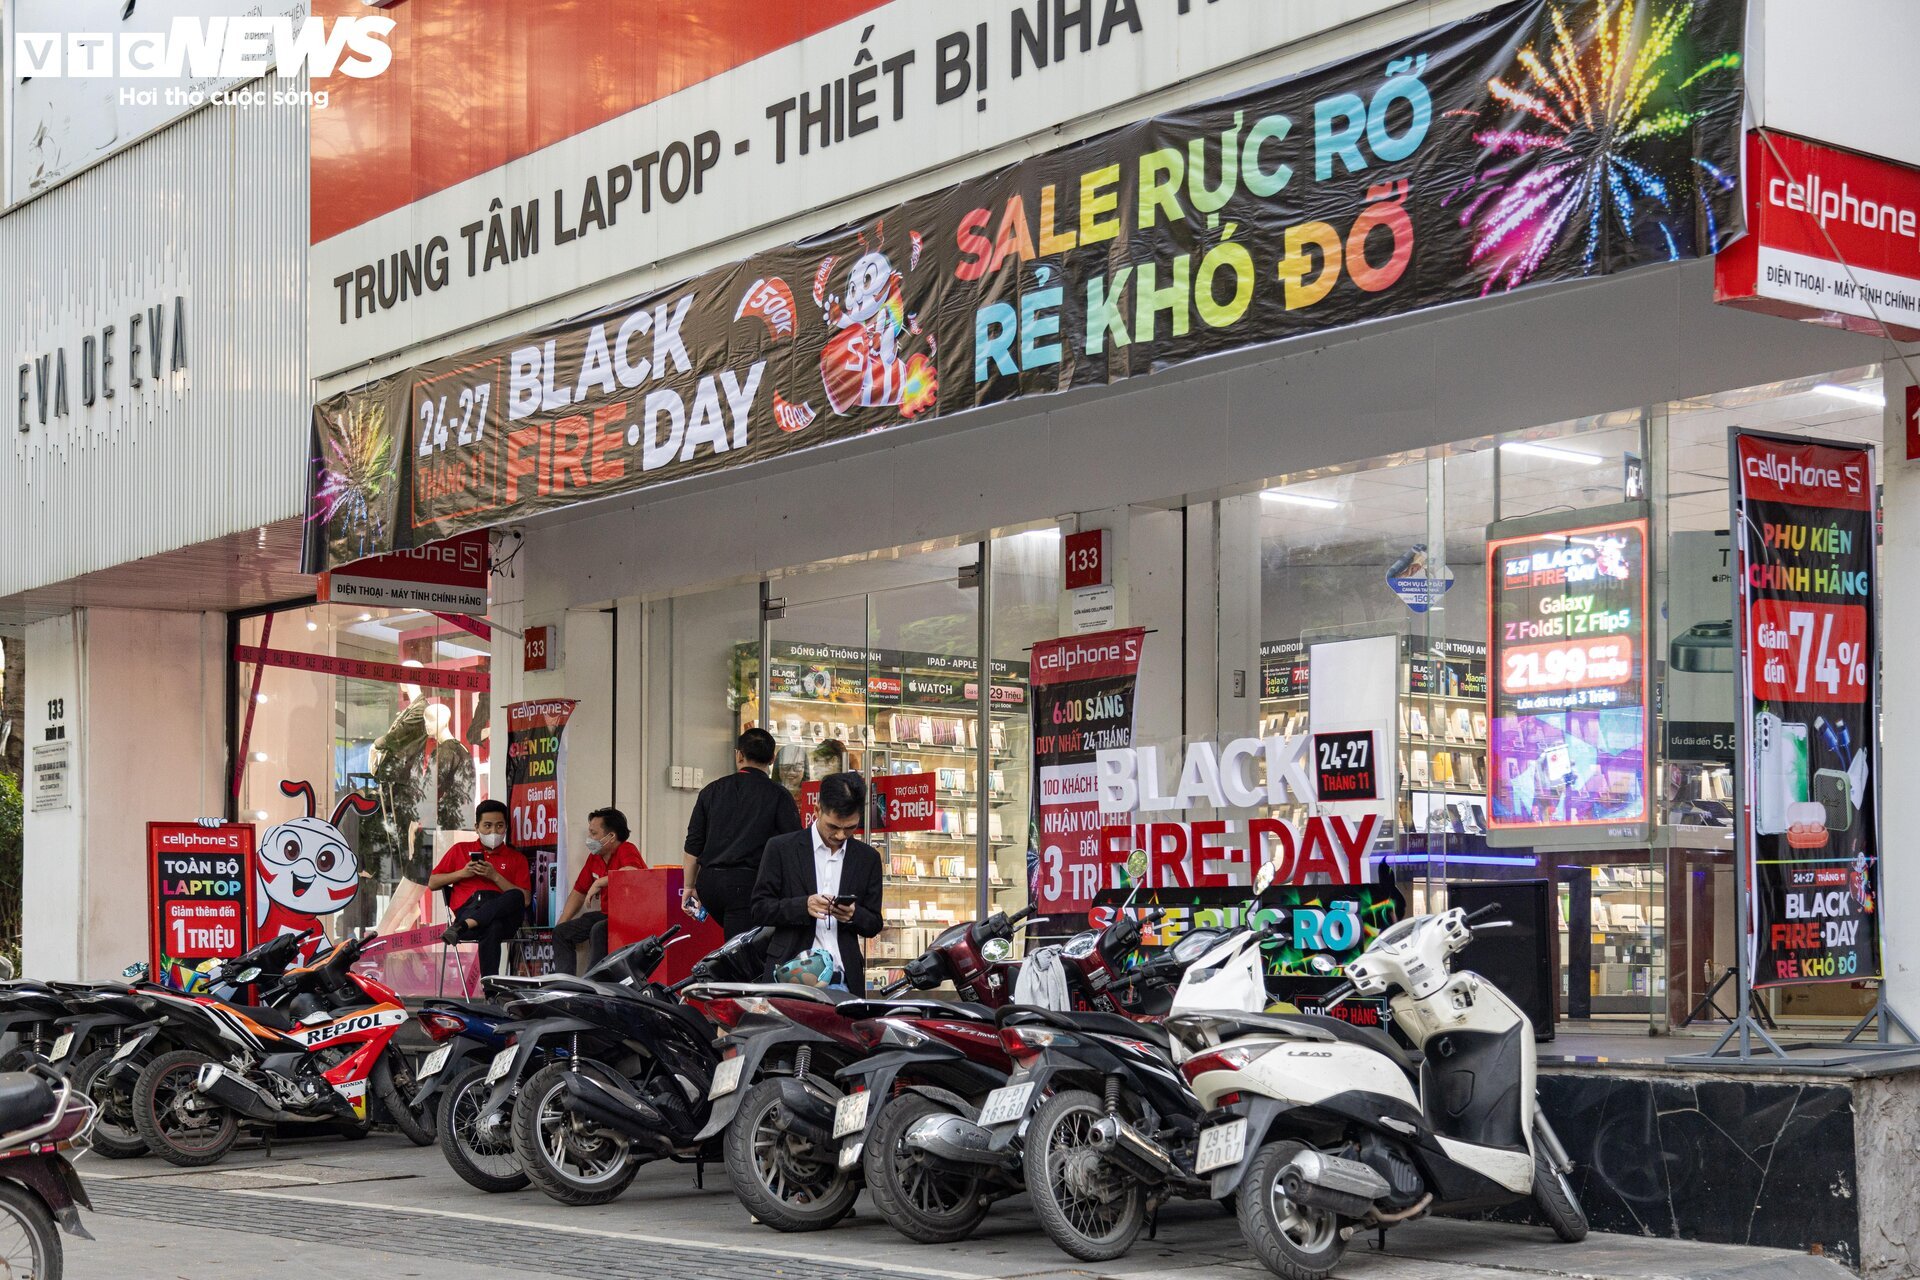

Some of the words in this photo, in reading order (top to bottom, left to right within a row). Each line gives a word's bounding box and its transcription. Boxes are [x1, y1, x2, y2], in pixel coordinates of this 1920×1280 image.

[333, 235, 449, 324] TRUNG
[460, 197, 540, 277] TÂM
[553, 130, 720, 246] LAPTOP
[766, 24, 915, 164] THIẾT
[936, 21, 988, 111] BỊ
[955, 165, 1120, 281] SALE
[1138, 110, 1293, 230] RỰC
[1769, 174, 1916, 237] cellphone
[1767, 265, 1791, 287] ĐIỆN
[1795, 271, 1824, 295] THOẠI
[1834, 280, 1857, 298] MÁY
[1857, 284, 1882, 305] TÍNH
[1884, 291, 1915, 312] CHÍNH
[751, 286, 792, 335] 500K
[975, 266, 1063, 383] RẺ
[1085, 223, 1255, 356] KHÓ
[18, 347, 69, 432] EVA
[81, 325, 115, 406] DE
[129, 296, 187, 389] EVA
[509, 292, 695, 421] BLACK
[419, 383, 491, 457] 24-27
[776, 402, 811, 428] 100K
[419, 457, 467, 502] THÁNG
[471, 451, 486, 488] 11
[1745, 453, 1841, 490] cellphone
[1763, 522, 1806, 557] PHỤ
[1810, 522, 1852, 560] KIỆN
[1069, 547, 1098, 572] 133
[1532, 548, 1585, 570] BLACK
[1749, 556, 1809, 592] CHÍNH
[1815, 563, 1868, 596] HÃNG
[337, 583, 357, 597] ĐIỆN
[359, 586, 383, 599] THOẠI
[391, 586, 408, 600] MÁY
[410, 590, 430, 602] TÍNH
[431, 591, 456, 604] CHÍNH
[459, 592, 481, 606] HÃNG
[1539, 594, 1594, 615] Galaxy
[1505, 623, 1517, 640] Z
[1519, 616, 1564, 639] Fold5
[1574, 614, 1587, 633] Z
[1589, 609, 1630, 632] Flip5
[526, 641, 545, 659] 133
[830, 648, 858, 660] THÔNG
[861, 651, 882, 661] MNH
[1039, 644, 1120, 671] cellphone
[1271, 642, 1304, 654] ANDROID
[1453, 643, 1475, 656] THOẠI
[1758, 622, 1789, 650] Giảm
[1789, 611, 1866, 694] 74%
[772, 669, 796, 678] BLACK
[927, 657, 946, 667] IPAD
[952, 659, 977, 669] APPLE
[991, 662, 1006, 671] TCH
[1763, 656, 1785, 683] đến
[467, 675, 479, 688] SALE
[918, 682, 952, 695] WATCH
[47, 698, 64, 720] 133
[1053, 700, 1082, 725] 6:00
[1085, 691, 1124, 721] SÁNG
[1578, 690, 1588, 703] 3
[512, 701, 562, 721] cellphone
[1036, 736, 1055, 755] DUY
[1058, 728, 1081, 752] NHẤT
[1083, 732, 1095, 750] 24
[1097, 725, 1130, 749] THÁNG
[1320, 740, 1369, 770] 24-27
[529, 759, 555, 777] IPAD
[1096, 733, 1319, 813] BLACK
[527, 787, 542, 801] Giảm
[543, 785, 556, 800] đến
[894, 786, 907, 797] TRỢ
[907, 785, 918, 795] GIÁ
[1043, 778, 1059, 796] 100
[1062, 773, 1092, 794] KHÁCH
[1322, 771, 1356, 792] THÁNG
[1357, 772, 1369, 790] 11
[890, 799, 900, 821] 3
[901, 798, 934, 821] TRIỆU
[1044, 807, 1078, 836] NHẬN
[513, 804, 546, 841] 16.8
[163, 833, 226, 848] cellphone
[1080, 834, 1098, 857] ĐẾN
[164, 857, 211, 874] TOÀN
[216, 858, 239, 877] BỘ
[1043, 845, 1063, 901] 3
[1793, 872, 1814, 883] 24-27
[1817, 873, 1839, 882] THÁNG
[163, 879, 242, 896] LAPTOP
[171, 905, 194, 918] Giảm
[196, 905, 218, 917] thêm
[219, 904, 235, 917] đến
[1785, 891, 1851, 919] BLACK
[172, 919, 185, 954] 1
[188, 924, 235, 952] TRIỆU
[1776, 952, 1799, 979] RẺ
[1802, 952, 1835, 977] KHÓ
[1350, 1004, 1377, 1024] HÀNG
[307, 1013, 382, 1045] REPSOL
[339, 1080, 364, 1089] HONDA
